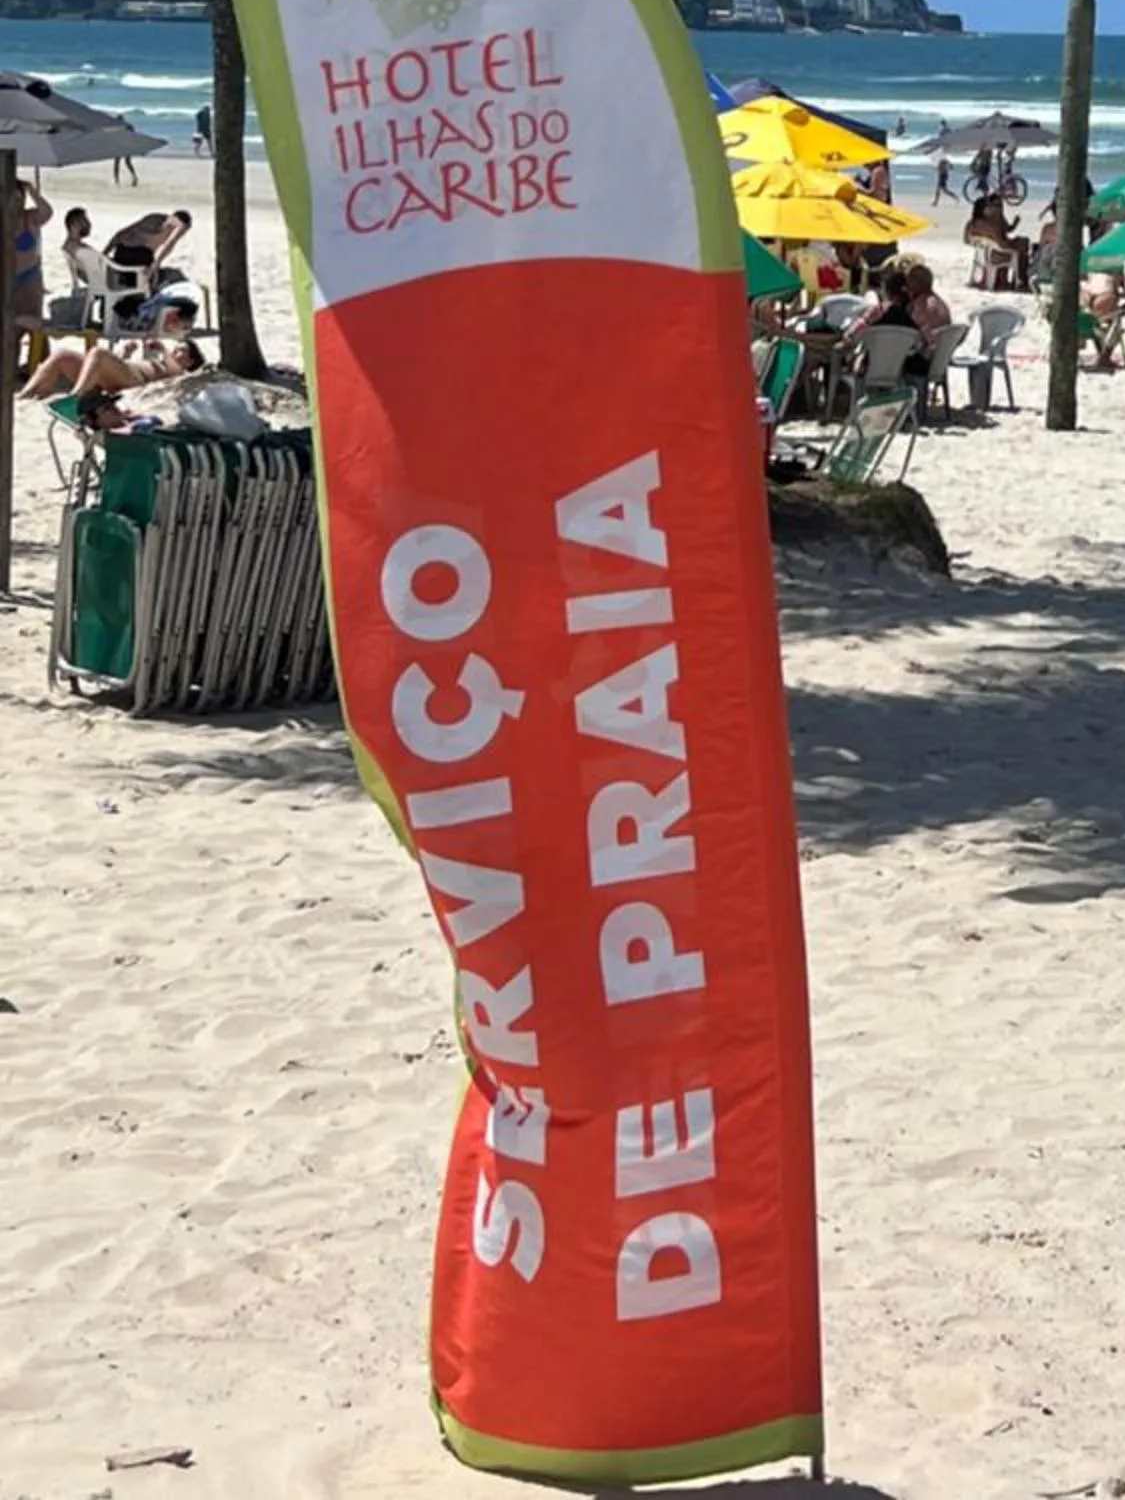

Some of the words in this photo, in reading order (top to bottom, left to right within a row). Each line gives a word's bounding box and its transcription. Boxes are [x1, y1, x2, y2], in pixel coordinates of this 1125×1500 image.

[320, 29, 564, 114] HOTEL
[335, 101, 495, 173] ILHAS
[510, 110, 569, 150] DO
[346, 151, 578, 233] CARIBE
[555, 450, 706, 1006] PRAIA
[381, 524, 549, 1283] SERVIÇO
[616, 1088, 721, 1321] DE
